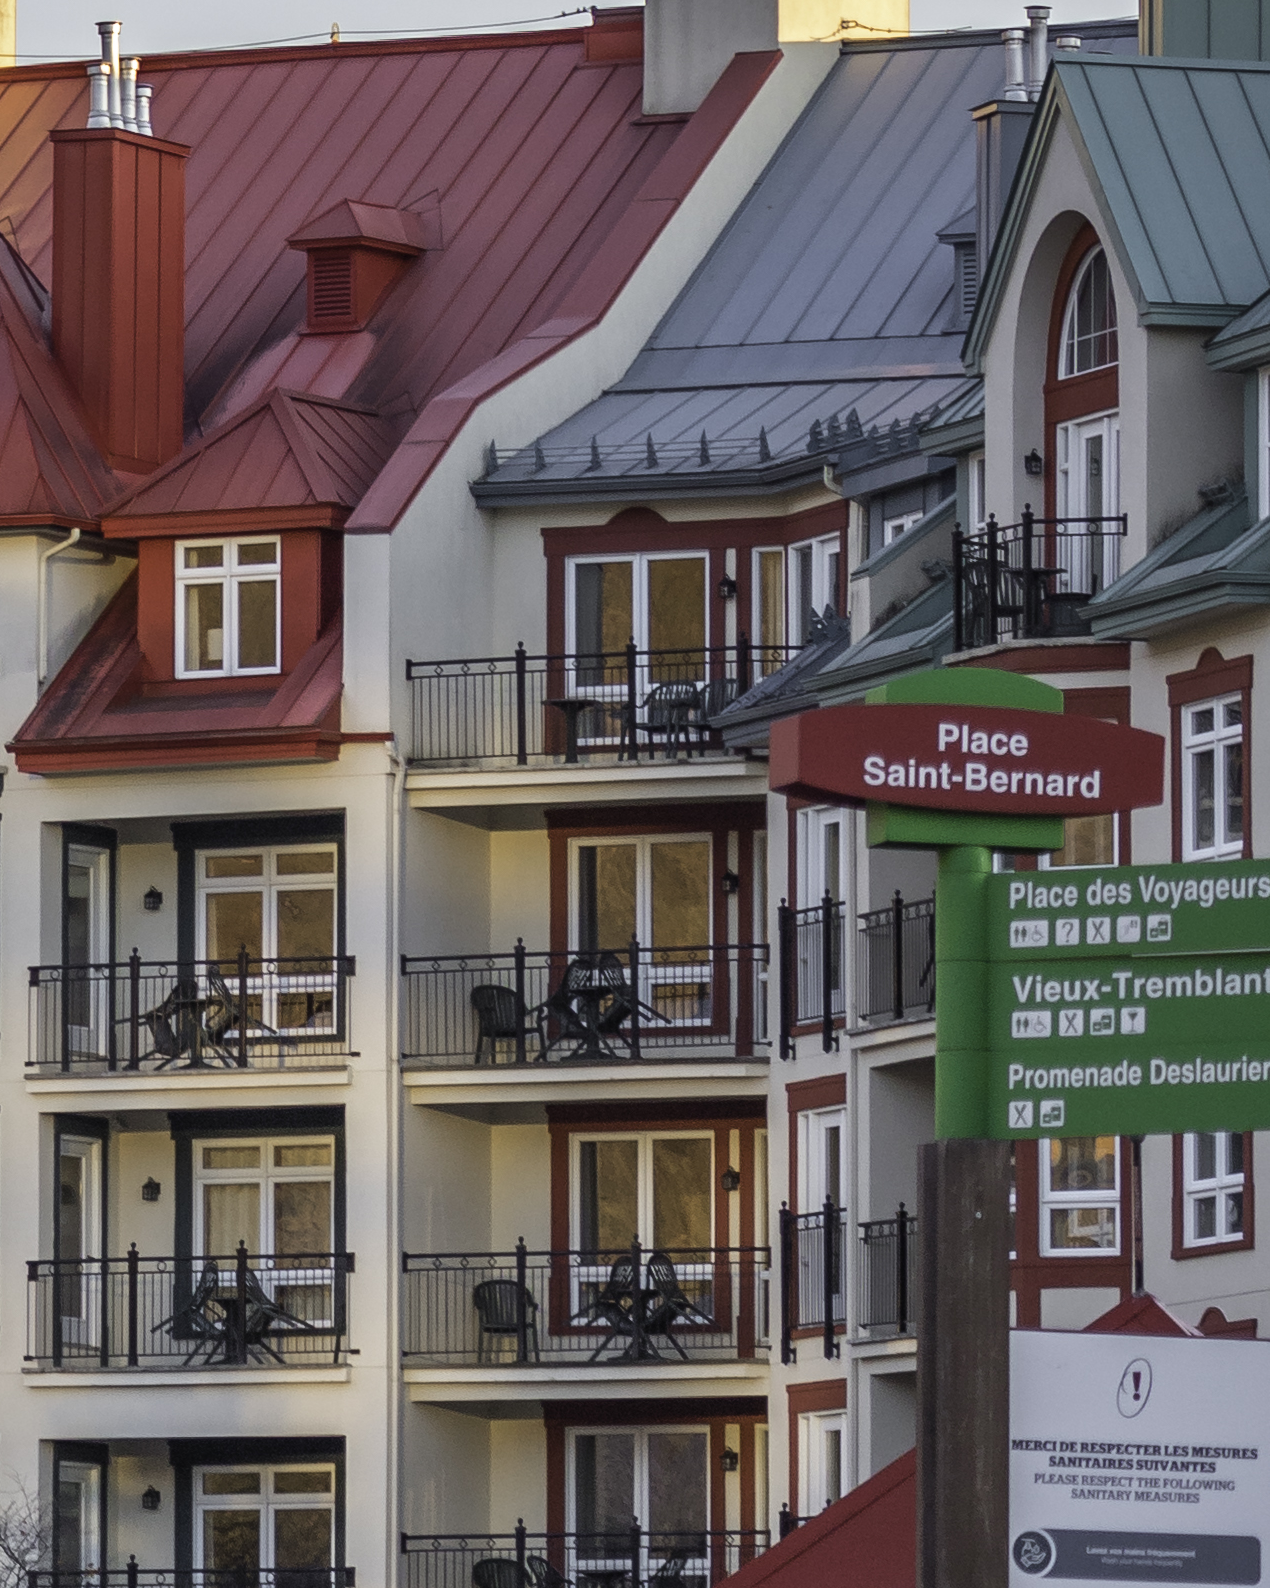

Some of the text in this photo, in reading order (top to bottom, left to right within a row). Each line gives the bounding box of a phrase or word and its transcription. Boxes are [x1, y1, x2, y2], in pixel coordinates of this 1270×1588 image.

[938, 723, 1029, 756] Place
[863, 756, 1101, 799] Saint-Bernard
[1010, 874, 1270, 910] Place des Voyageurs
[1012, 967, 1270, 1004] Vieux-Tremblant
[1009, 1059, 1142, 1090] Promenade
[1011, 1439, 1258, 1460] MERCI DE RESPECTER LES MESURES
[1049, 1456, 1217, 1473] SANITAIRES SUIVANTES
[1034, 1473, 1235, 1491] PLEASE RESPECT THE FOLLOWING
[1071, 1488, 1200, 1503] SANITARY MEASURES
